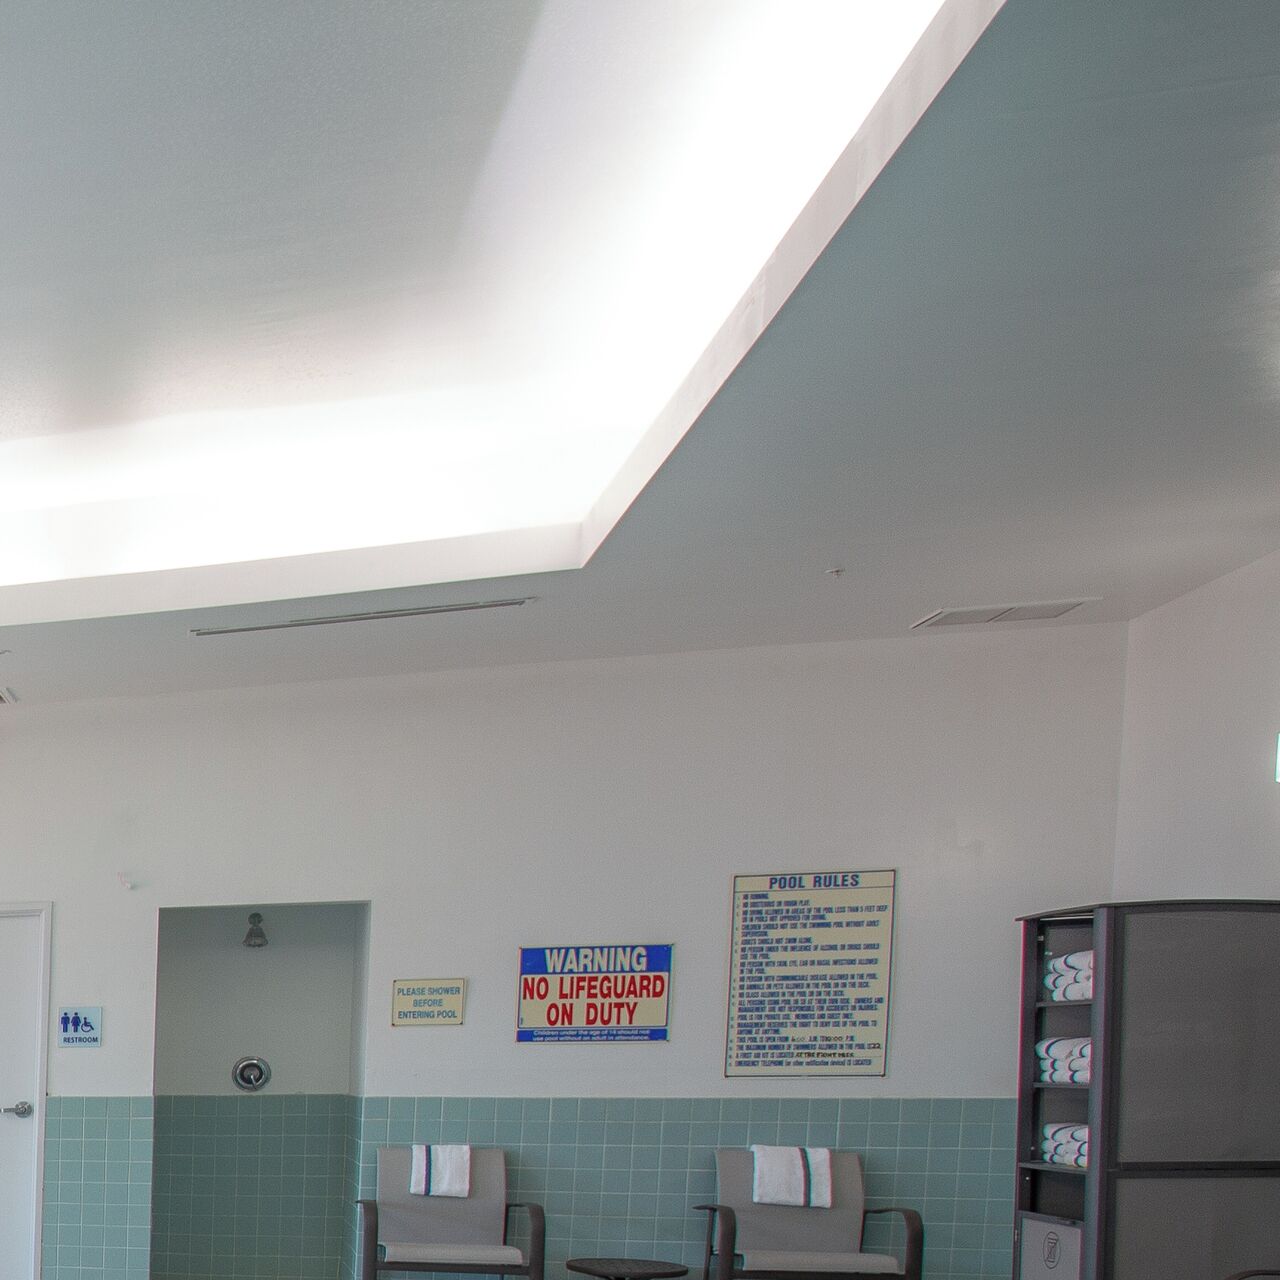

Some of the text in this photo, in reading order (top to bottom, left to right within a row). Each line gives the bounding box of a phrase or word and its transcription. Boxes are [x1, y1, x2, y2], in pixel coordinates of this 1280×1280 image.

[768, 874, 859, 889] POOL RULES
[544, 947, 647, 972] WARNING
[397, 987, 461, 996] PLEASE SHOWER
[523, 975, 665, 1000] NO LIFEGUARD
[413, 999, 443, 1007] BEFORE
[398, 1010, 457, 1019] ENTERING POOL
[546, 1002, 638, 1026] ON DUTY
